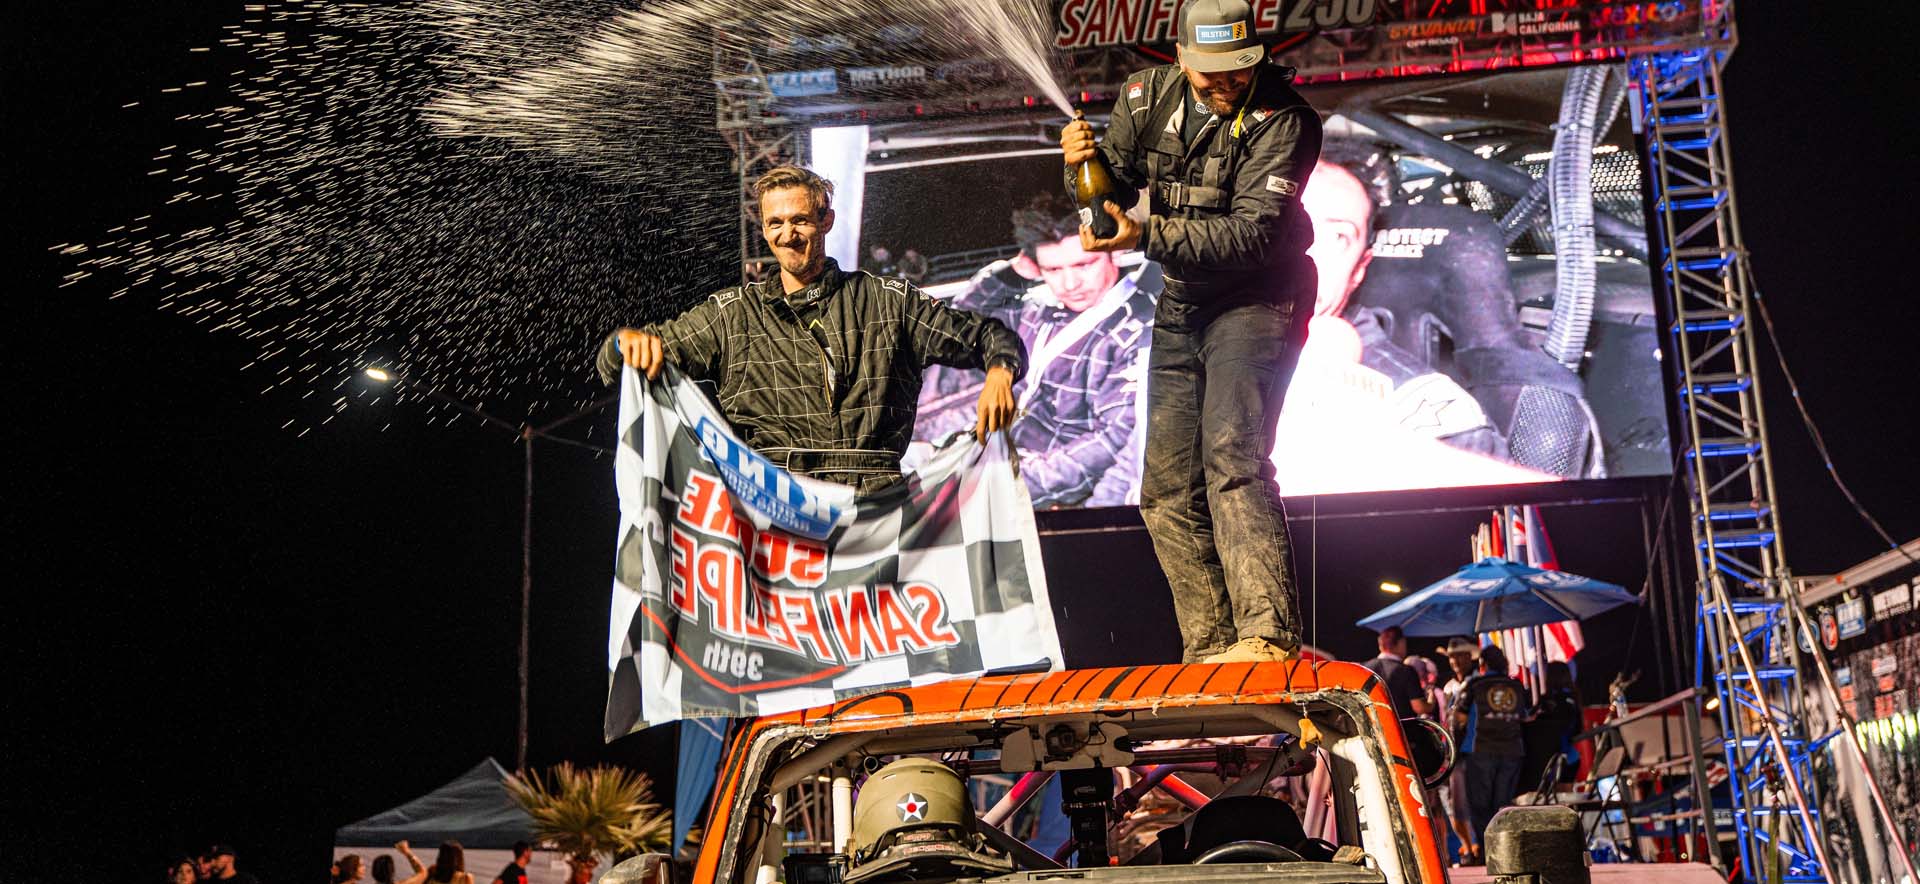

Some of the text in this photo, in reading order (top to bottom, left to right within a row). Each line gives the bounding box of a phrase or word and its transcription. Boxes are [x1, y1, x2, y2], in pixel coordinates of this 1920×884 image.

[1055, 0, 1145, 47] SAN
[1389, 19, 1476, 39] SYLVANIA
[1518, 20, 1580, 36] CALIFORNIA
